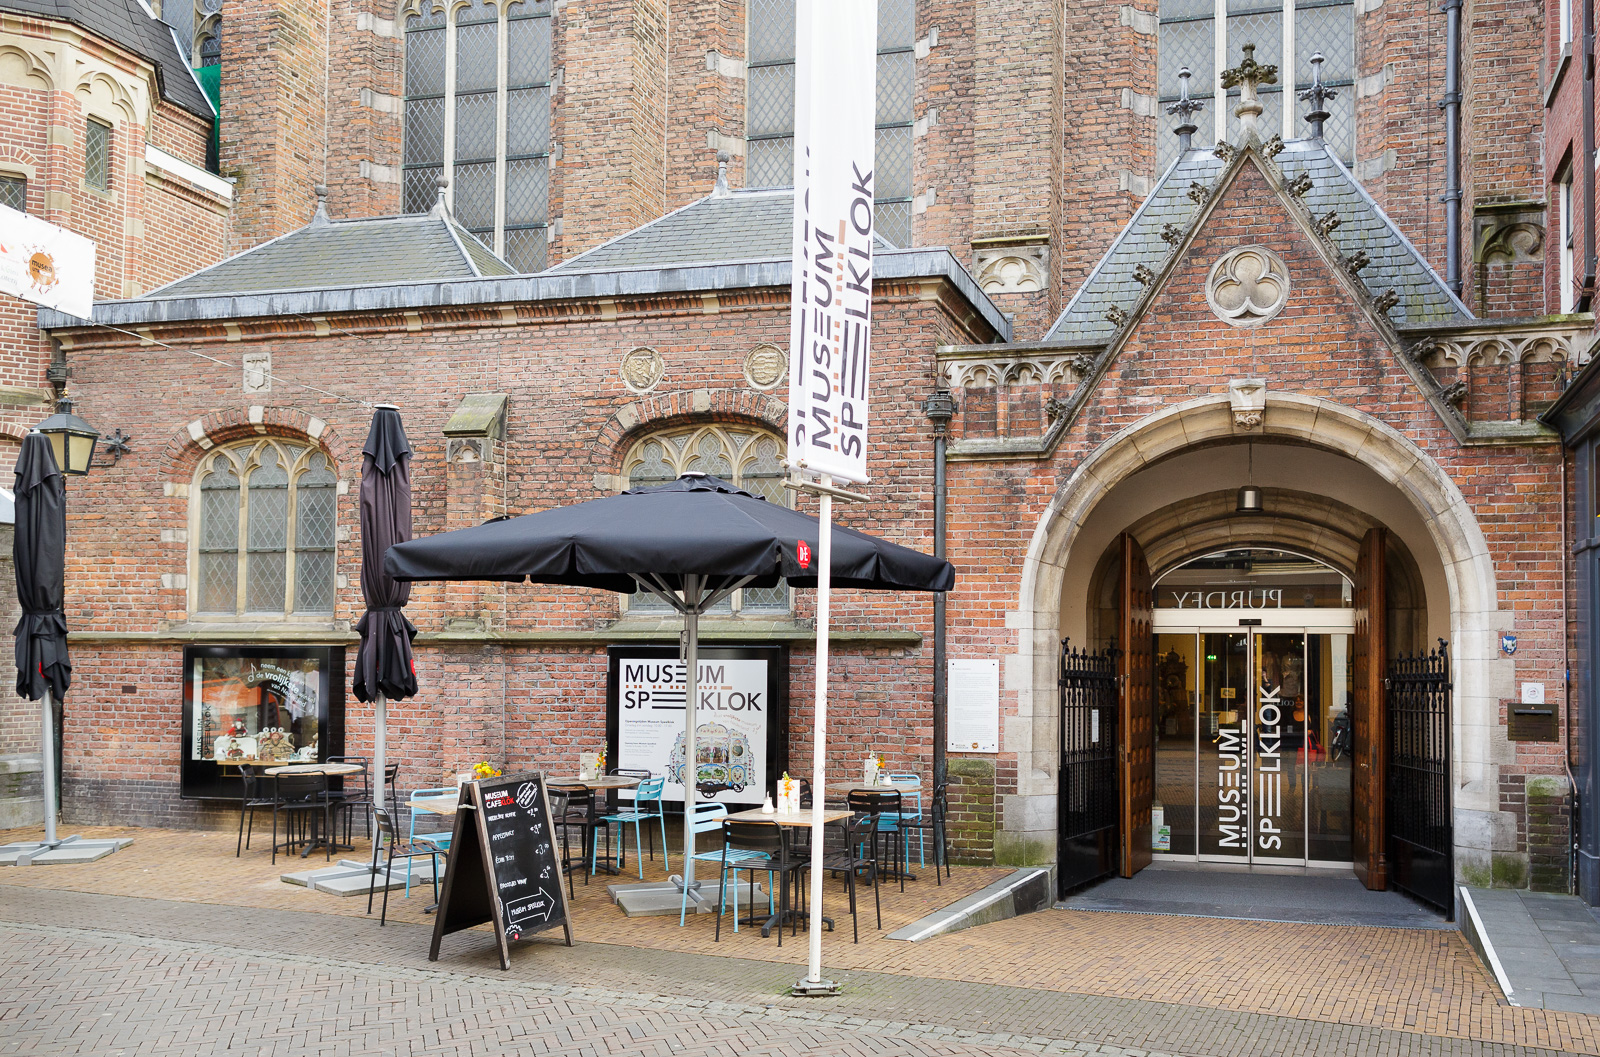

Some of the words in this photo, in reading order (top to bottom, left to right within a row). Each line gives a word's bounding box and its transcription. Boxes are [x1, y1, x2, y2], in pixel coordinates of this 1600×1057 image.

[812, 226, 835, 450] MUSEUM
[485, 790, 509, 800] MUSEUM
[1218, 728, 1241, 848] MUSEUM
